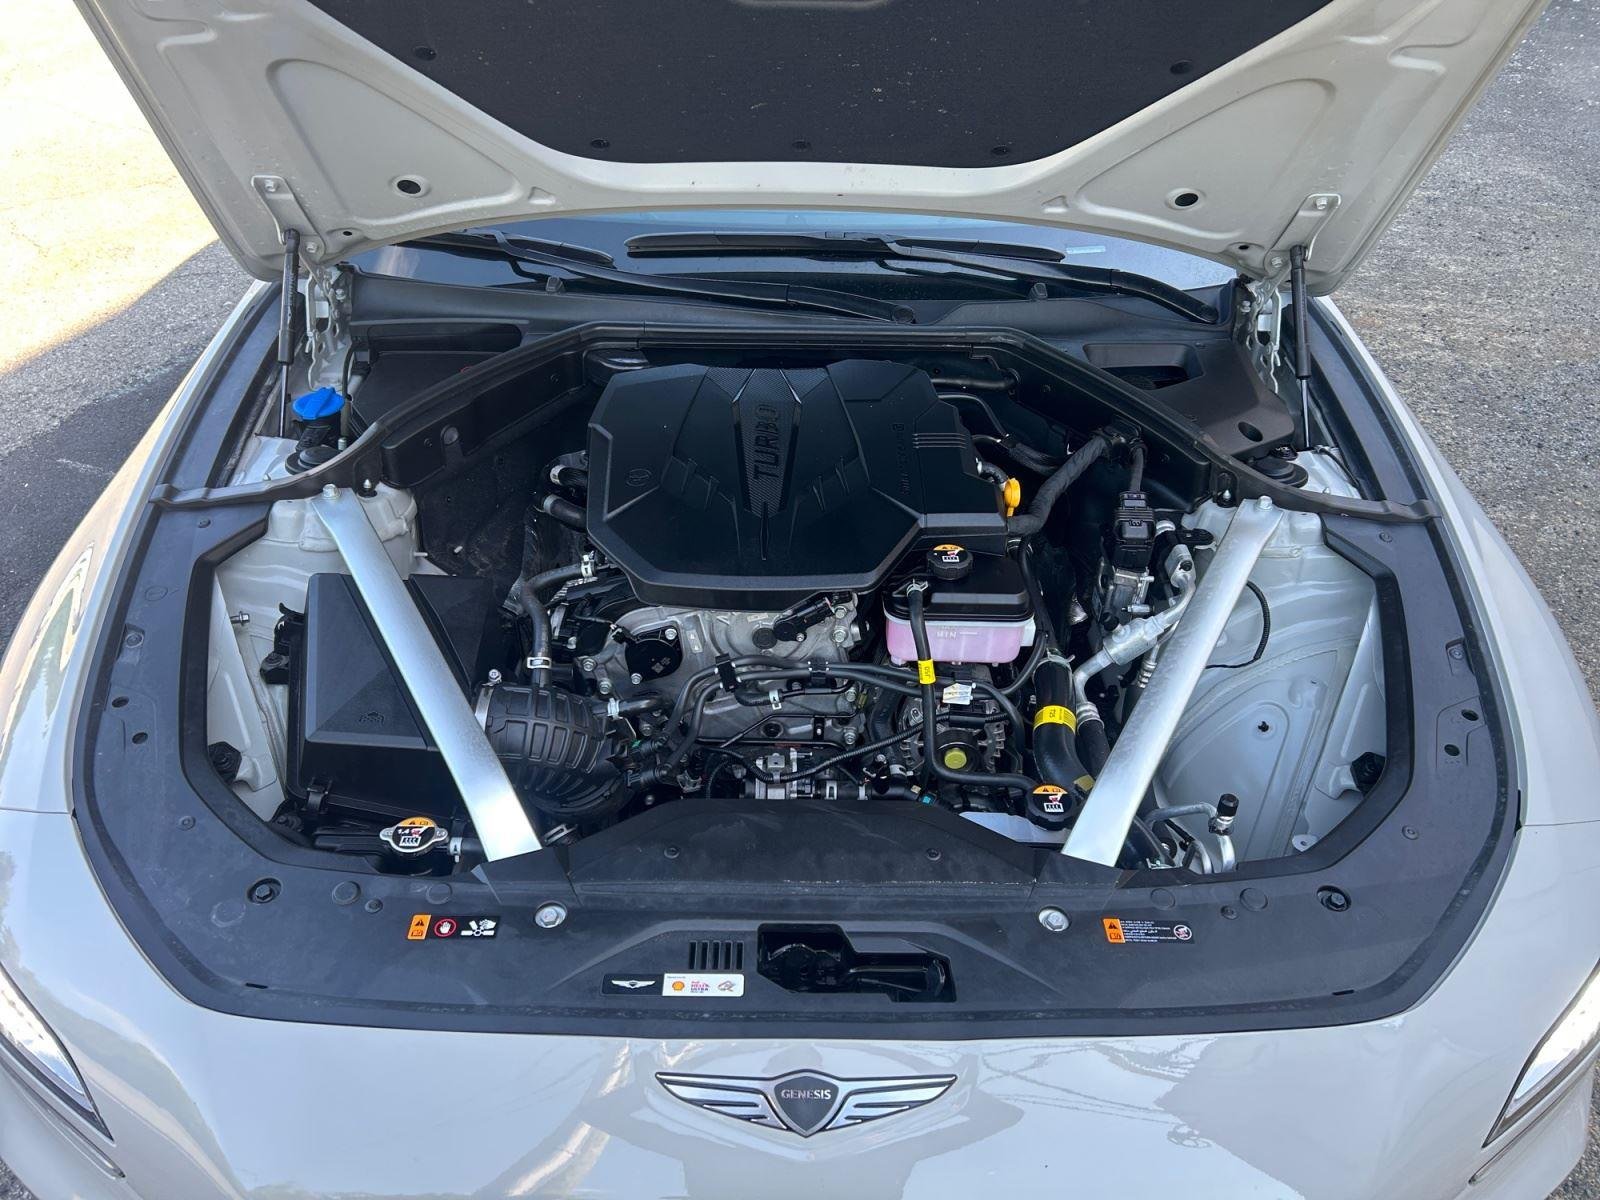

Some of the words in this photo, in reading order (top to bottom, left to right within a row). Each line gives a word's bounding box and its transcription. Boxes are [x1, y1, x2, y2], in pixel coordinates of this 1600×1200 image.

[753, 402, 779, 481] TURBO
[936, 631, 957, 639] MIN
[781, 1089, 832, 1100] GENESIS
